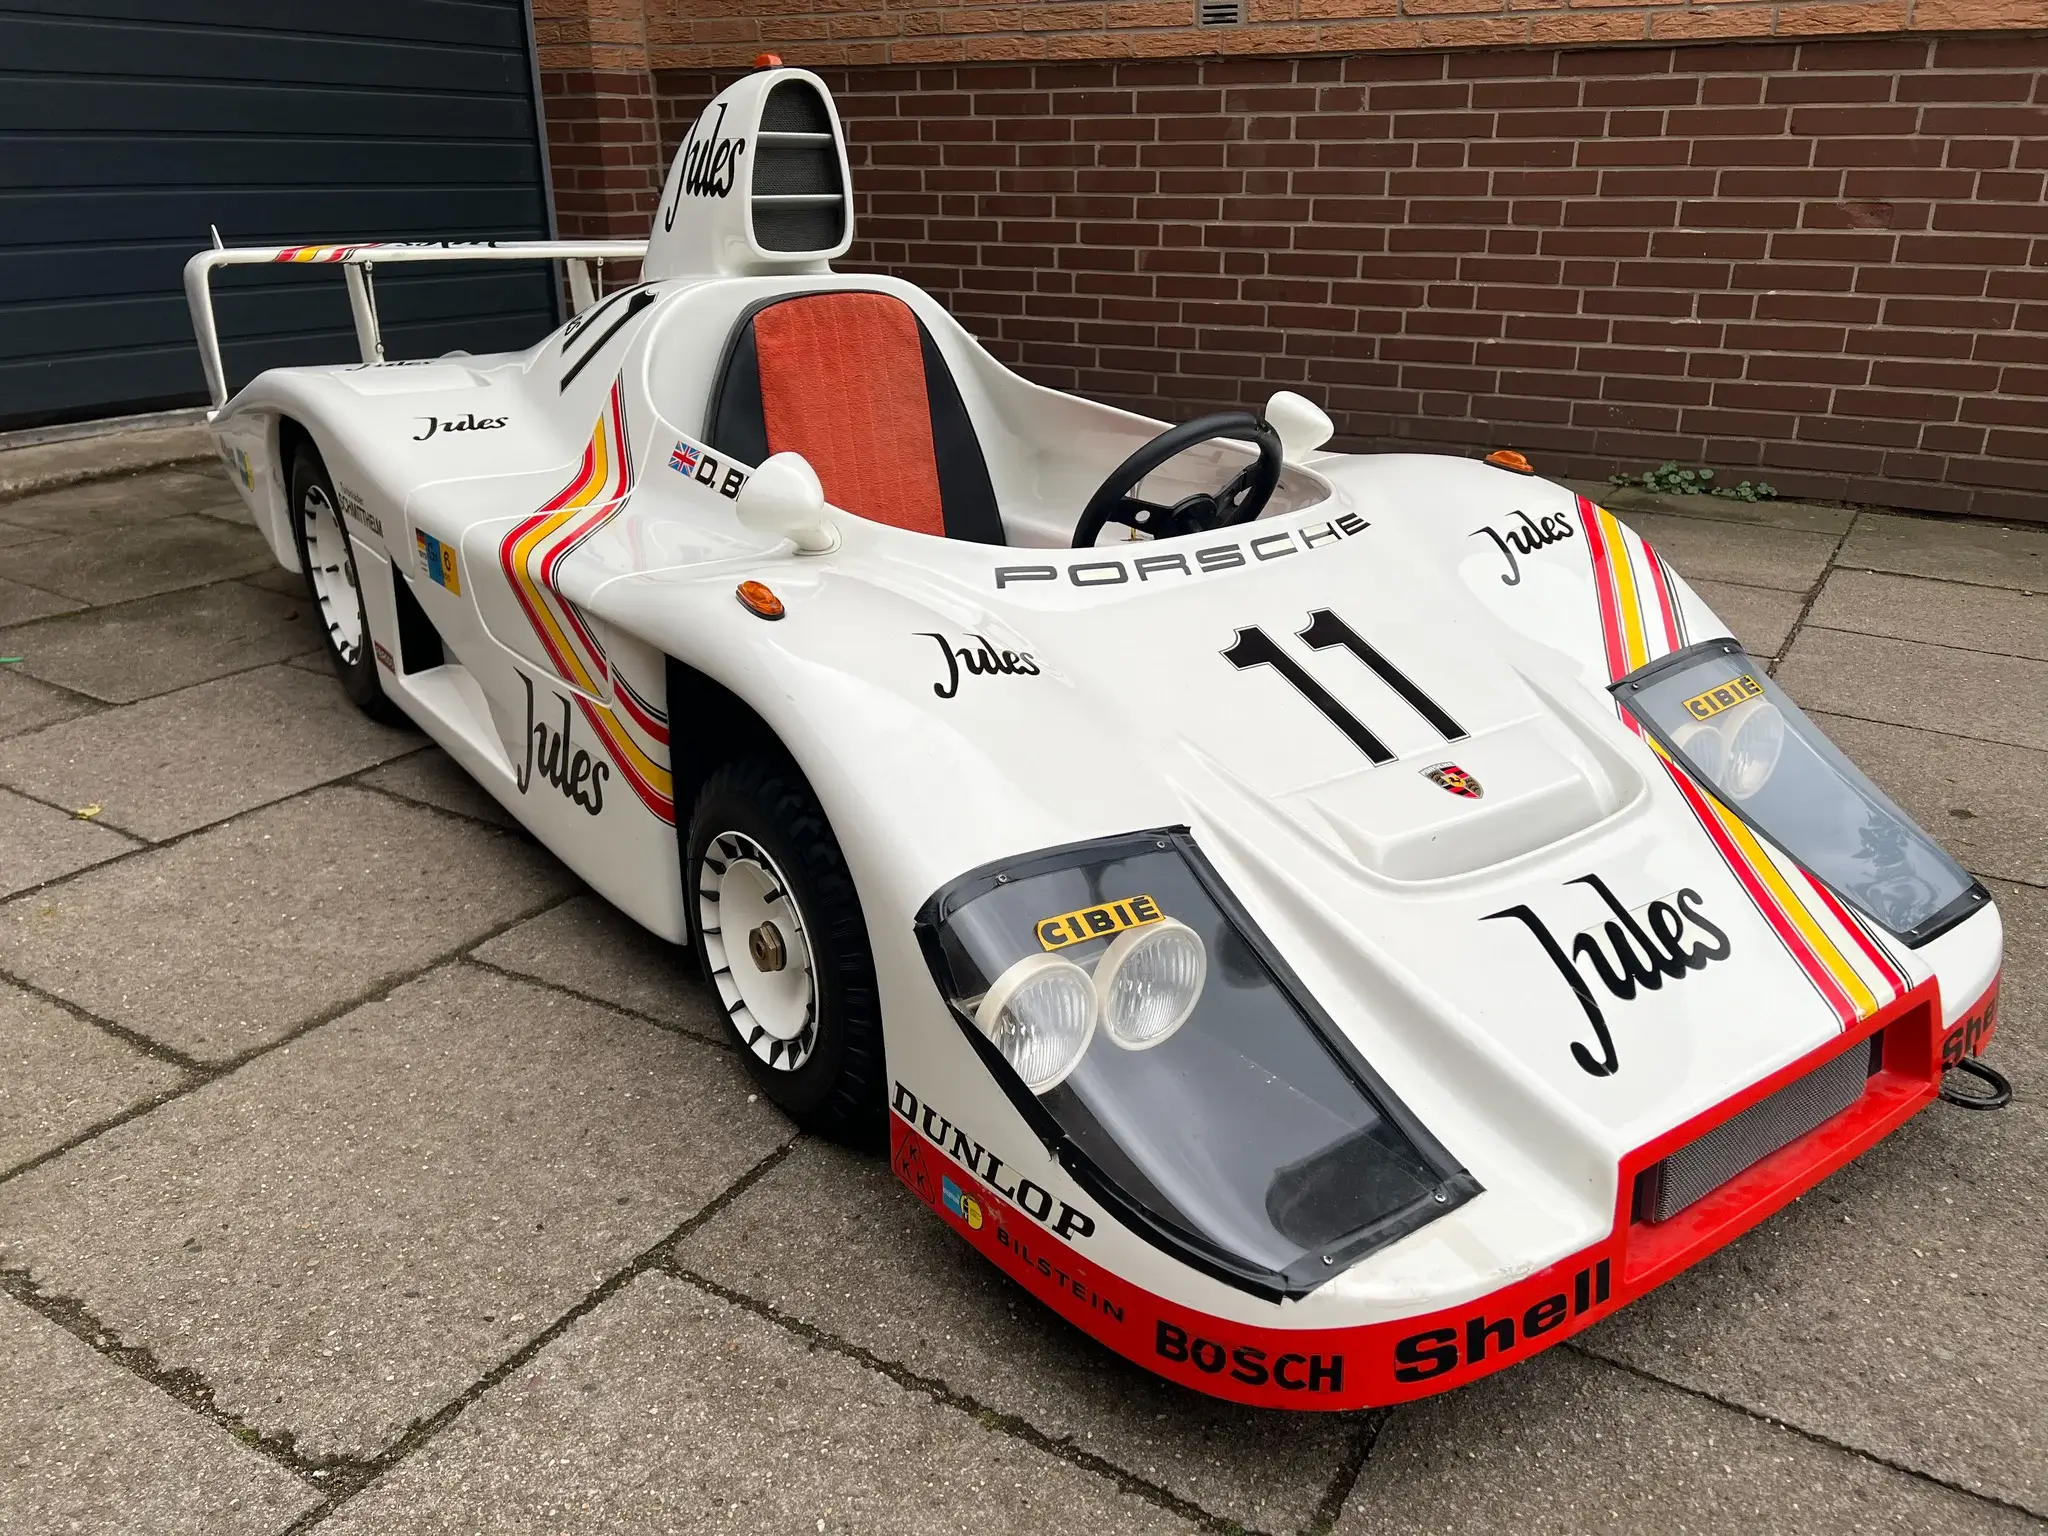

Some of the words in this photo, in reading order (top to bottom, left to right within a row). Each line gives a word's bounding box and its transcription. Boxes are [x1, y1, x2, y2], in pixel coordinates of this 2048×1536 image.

[665, 103, 745, 233] Jules
[412, 413, 509, 441] Jules
[694, 455, 718, 489] D.
[720, 467, 749, 502] B
[994, 512, 1371, 589] PORSCHE
[1468, 509, 1574, 586] Jules
[912, 633, 1041, 699] Jules
[1218, 607, 1471, 767] 11
[513, 666, 609, 816] Jules
[1478, 873, 1731, 1077] Jules
[892, 1080, 1096, 1241] DUNLOP
[997, 1226, 1125, 1323] BILSTEIN
[1395, 1258, 1612, 1384] Shell
[1155, 1320, 1344, 1393] BOSCH
